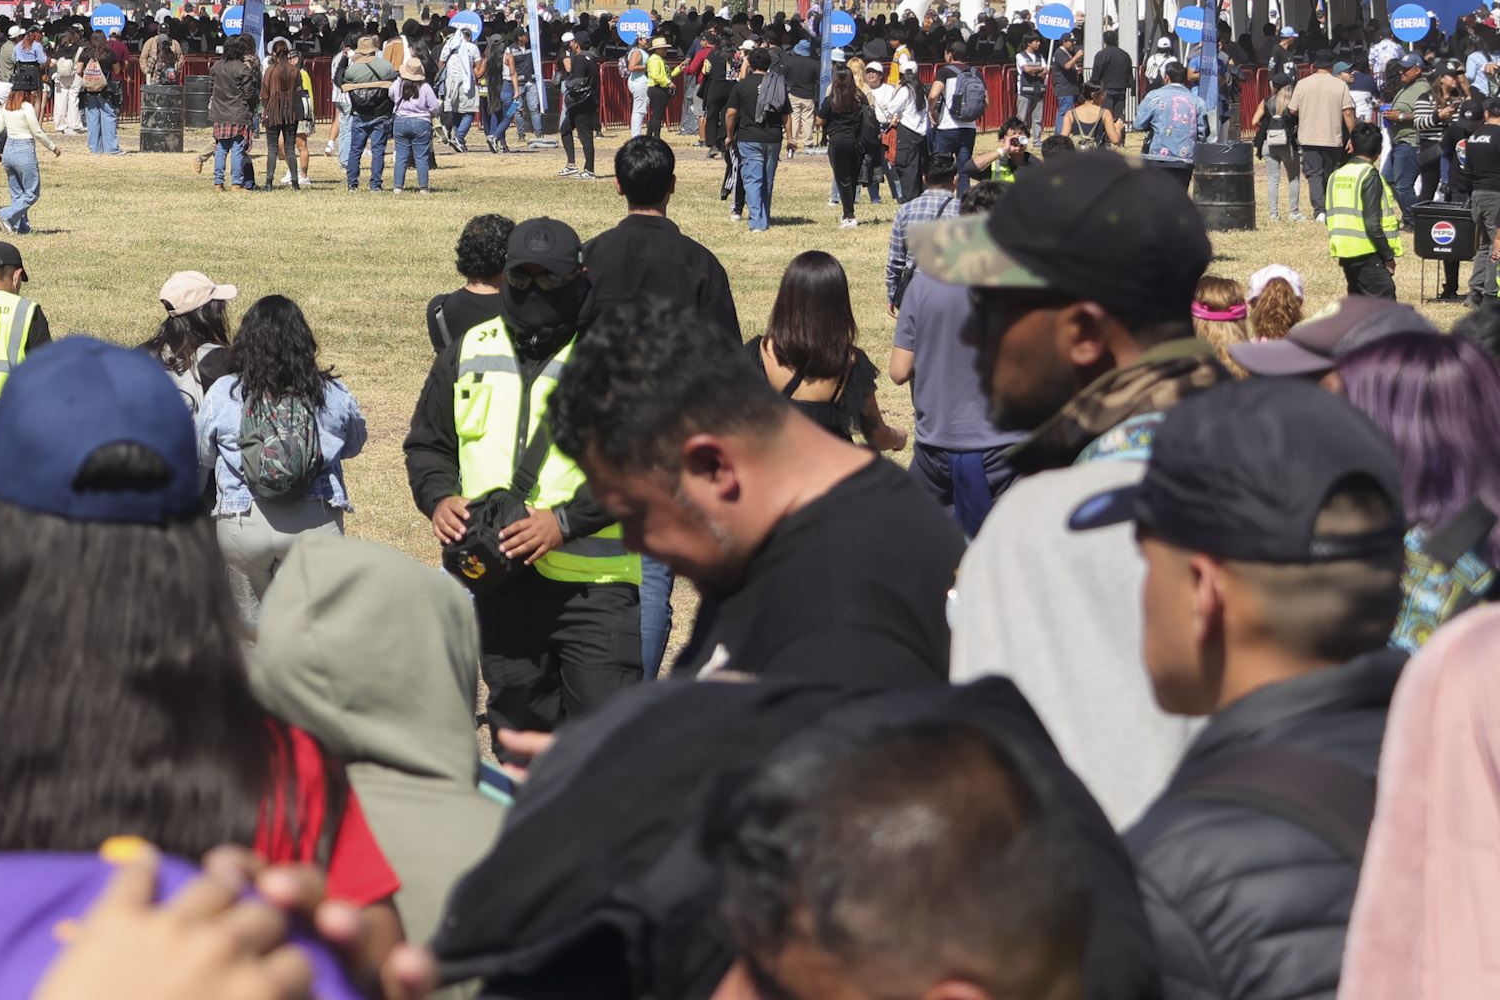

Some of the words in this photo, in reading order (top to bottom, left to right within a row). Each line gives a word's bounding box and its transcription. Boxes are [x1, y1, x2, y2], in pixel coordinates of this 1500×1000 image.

[93, 16, 122, 26] GENERAL
[225, 19, 243, 28] GENE
[620, 21, 650, 31] GENERAL
[1038, 15, 1071, 29] GENERAL
[1177, 17, 1203, 30] GENERA
[1393, 18, 1428, 29] GENERAL
[831, 24, 853, 34] NERAL
